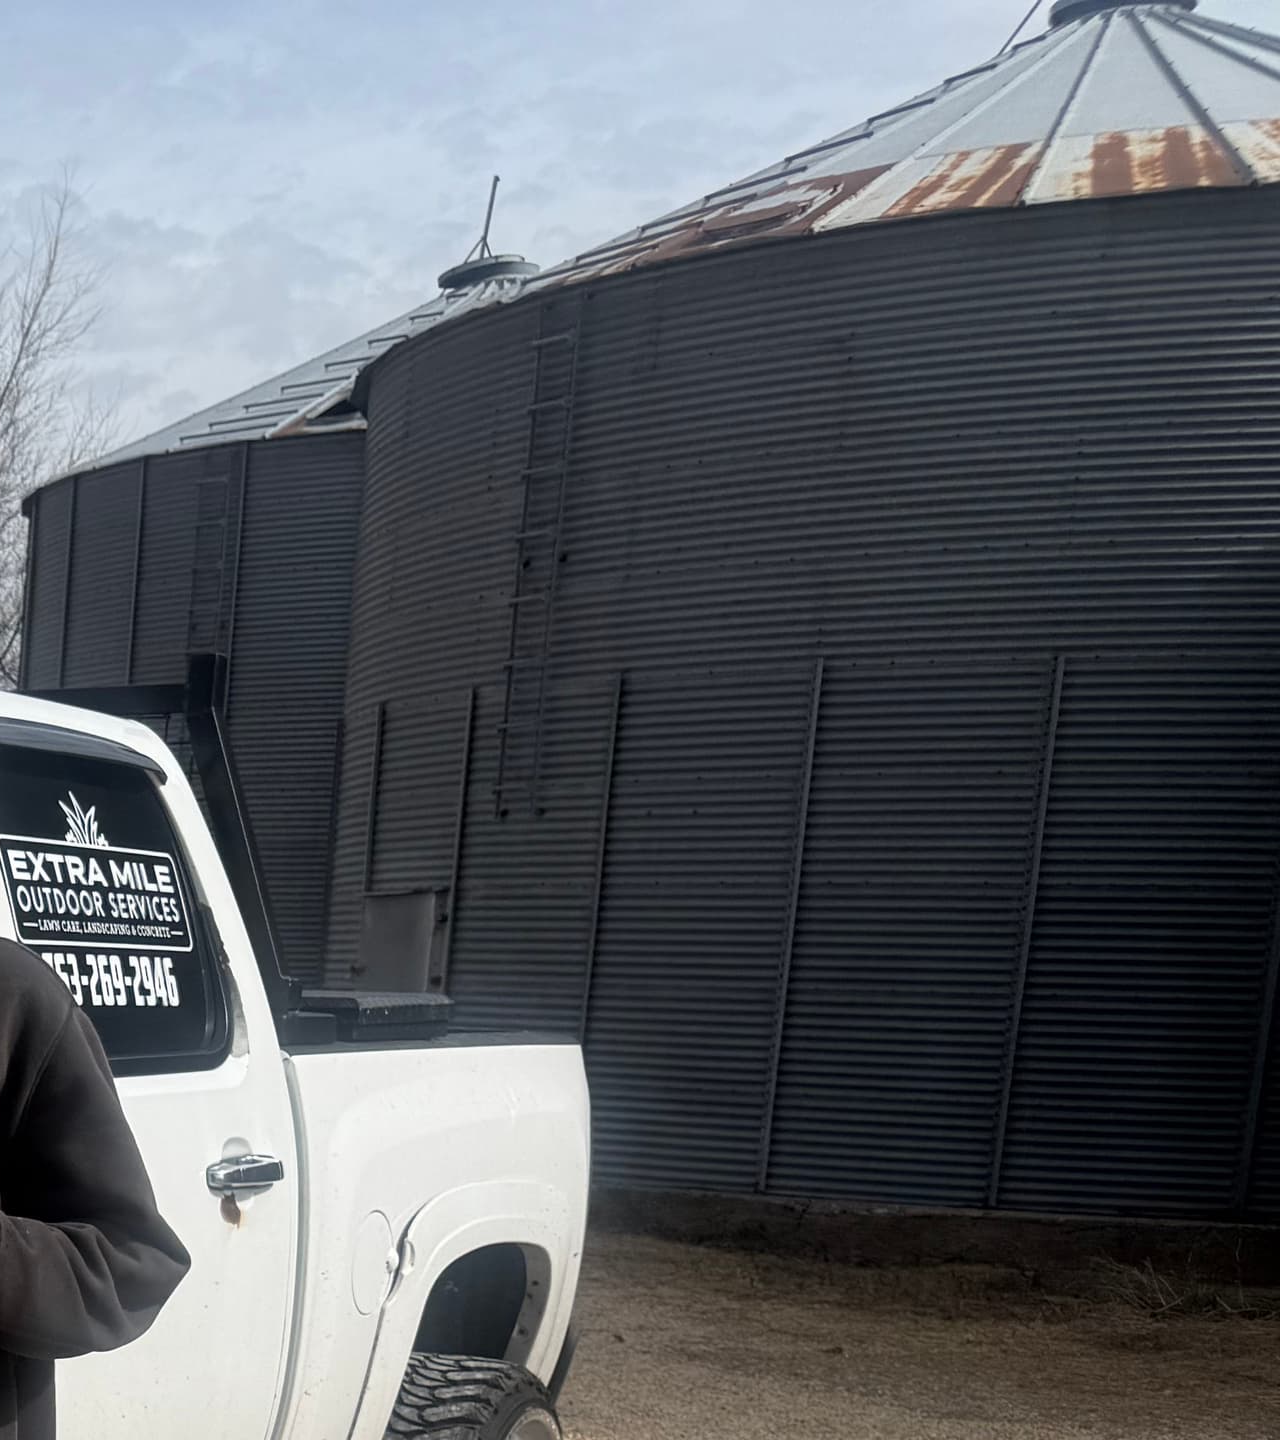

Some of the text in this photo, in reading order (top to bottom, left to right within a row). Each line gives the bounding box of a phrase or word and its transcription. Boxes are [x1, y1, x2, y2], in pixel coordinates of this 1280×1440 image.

[7, 849, 175, 894] EXTRA MILE
[16, 885, 181, 923] OUTDOOR SERVICES
[38, 919, 61, 932] LAWN
[137, 926, 172, 939] CONCRETE
